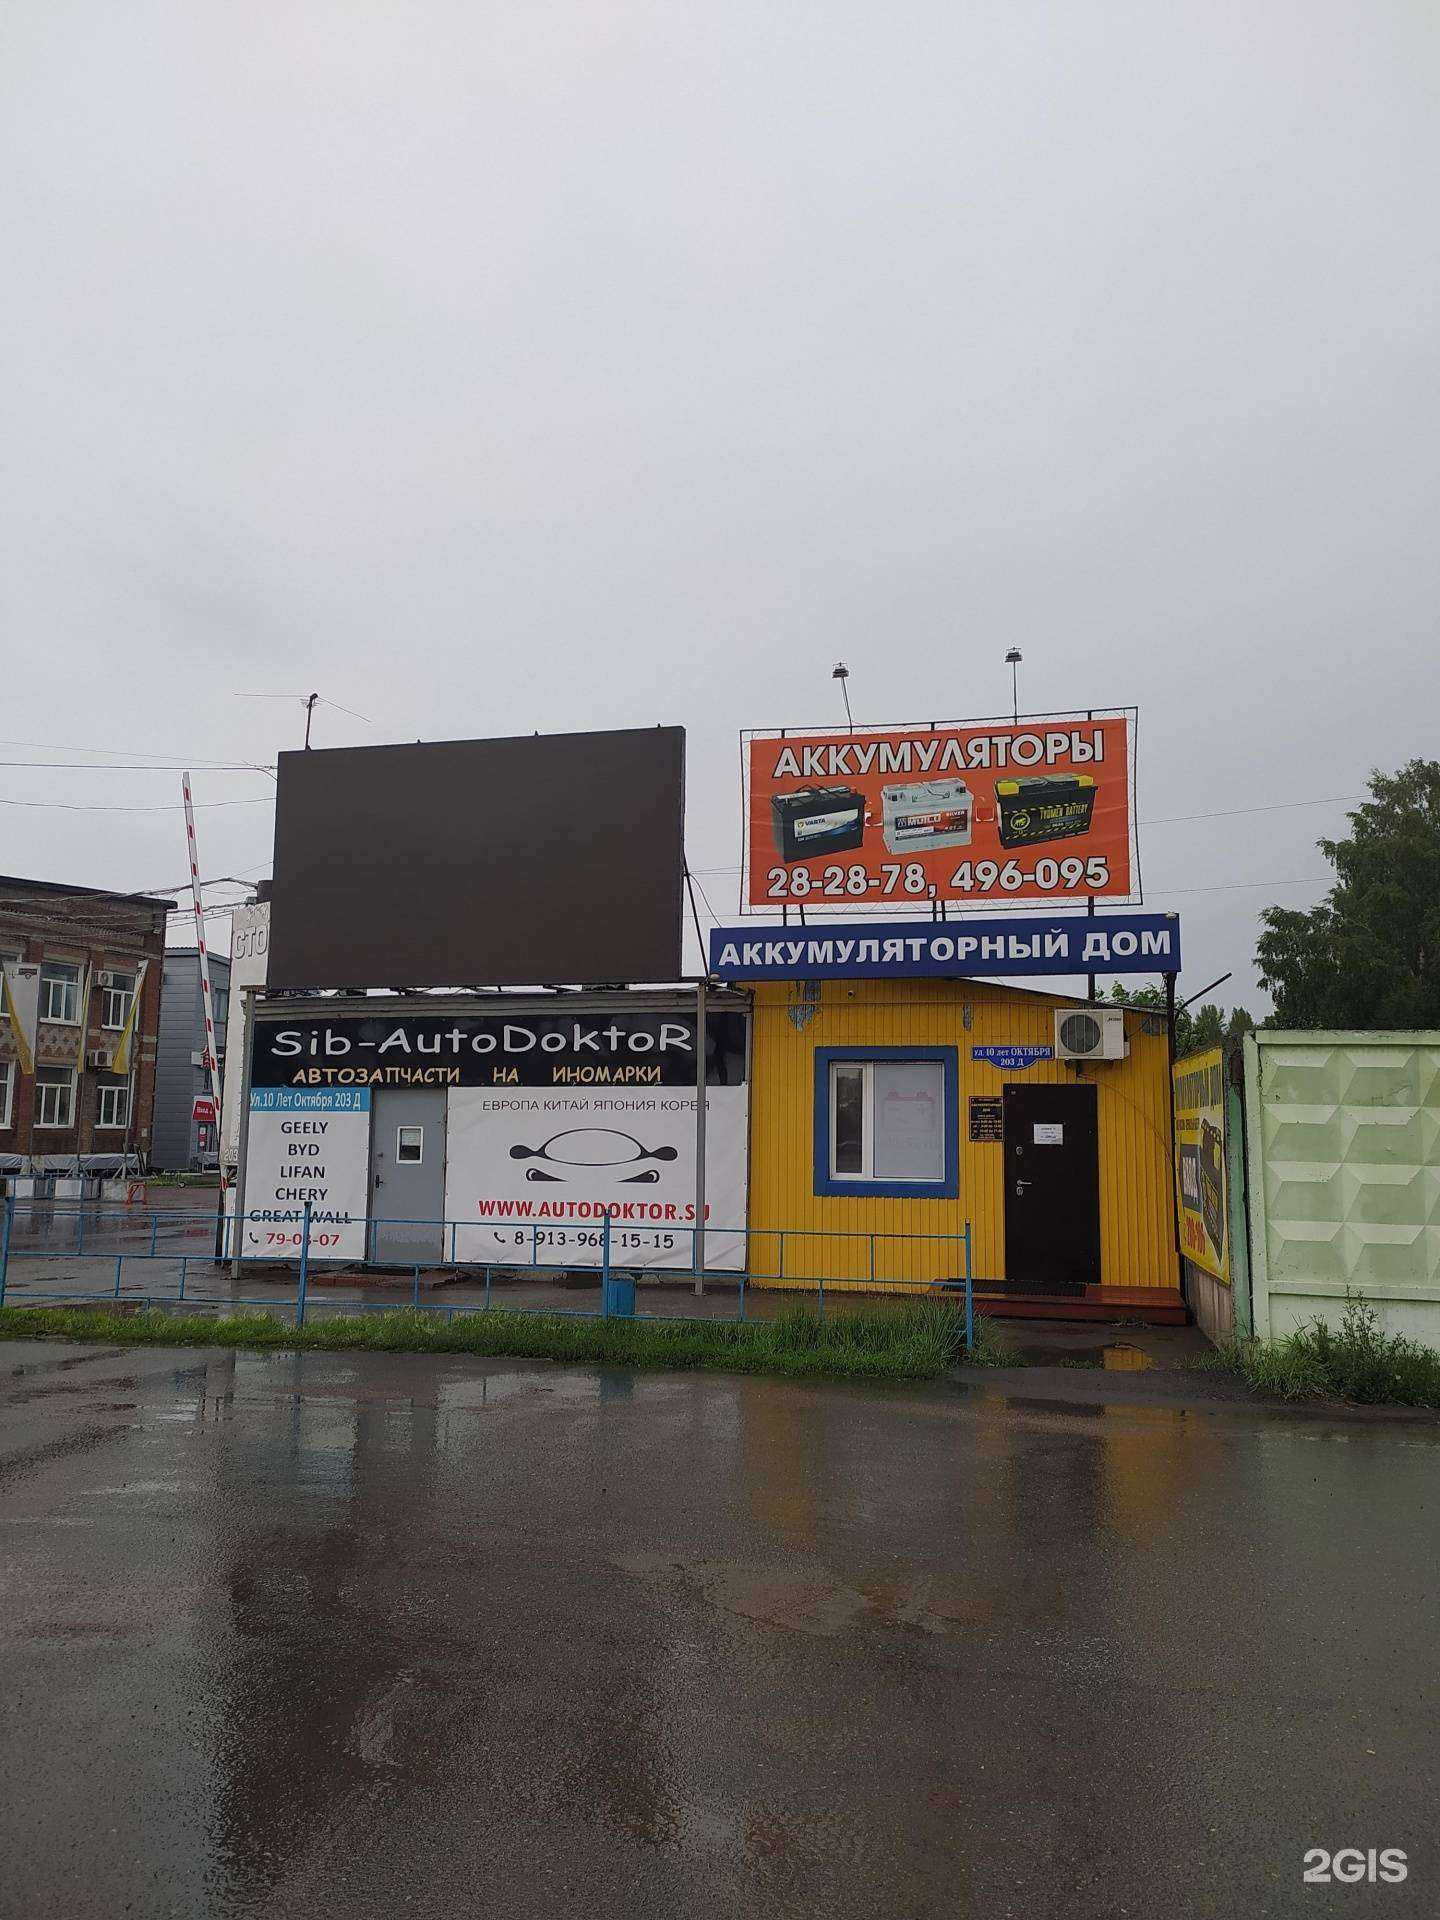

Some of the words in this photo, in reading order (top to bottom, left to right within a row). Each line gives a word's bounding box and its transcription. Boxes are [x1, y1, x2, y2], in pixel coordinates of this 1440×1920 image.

[773, 730, 1104, 777] АККУМУЛЯТОРЫ
[805, 818, 826, 826] VARTA
[767, 865, 938, 897] 28-28-78,
[949, 857, 1110, 892] 496-095
[233, 926, 267, 959] СТО
[719, 928, 1069, 966] АККУМУЛЯТОРНЫЙ
[1082, 930, 1172, 961] ДОМ
[270, 1024, 692, 1056] Sib-AutoDoktoR
[986, 1047, 995, 1056] 10
[1011, 1047, 1051, 1056] ОКТЯБРЯ
[1000, 1058, 1014, 1066] 203
[292, 1066, 461, 1085] АВТОЗАПЧАСТИ
[493, 1067, 520, 1083] НА
[552, 1065, 663, 1083] ИНОМАРКИ
[276, 1092, 292, 1107] Лет
[294, 1092, 332, 1109] Октября
[335, 1093, 351, 1106] 203
[353, 1093, 361, 1109] Д
[482, 1100, 538, 1111] ЕВРОПА
[543, 1097, 589, 1110] КИТАЙ
[593, 1100, 656, 1111] ЯПОНИЯ
[281, 1121, 328, 1134] GEELY
[224, 1148, 239, 1161] 203
[288, 1143, 320, 1156] BYD
[280, 1165, 325, 1178] LIFAN
[275, 1188, 328, 1201] CHERY
[250, 1209, 301, 1223] GREAT
